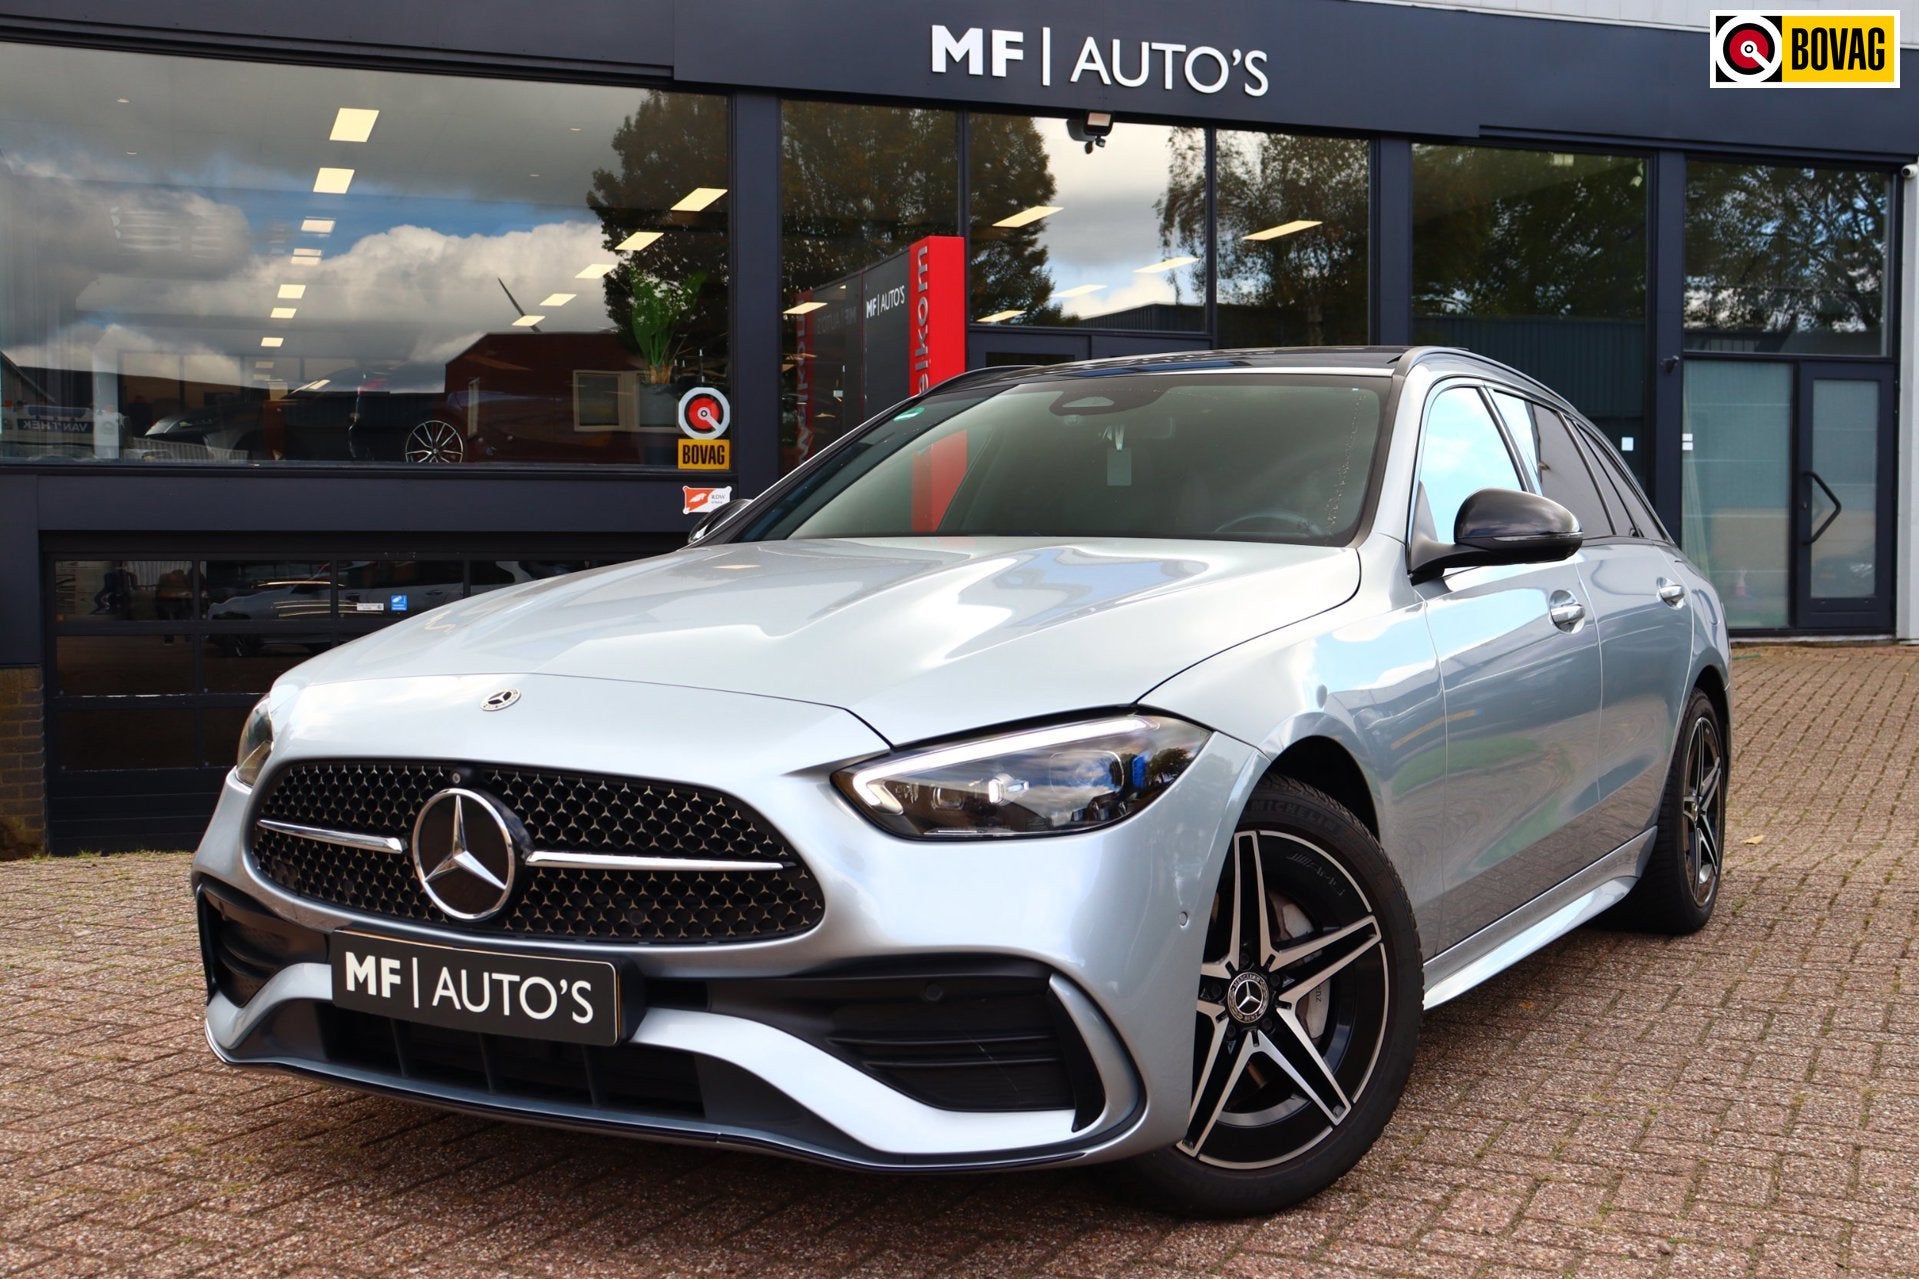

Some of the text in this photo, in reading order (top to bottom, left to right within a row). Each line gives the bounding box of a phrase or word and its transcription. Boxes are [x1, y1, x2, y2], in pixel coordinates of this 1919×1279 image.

[930, 24, 1270, 97] MF AUTO'S
[866, 285, 906, 318] MF AUTO'S
[914, 245, 929, 394] elkom
[682, 444, 726, 466] BOVAG
[345, 951, 594, 1025] MF AUTO'S
